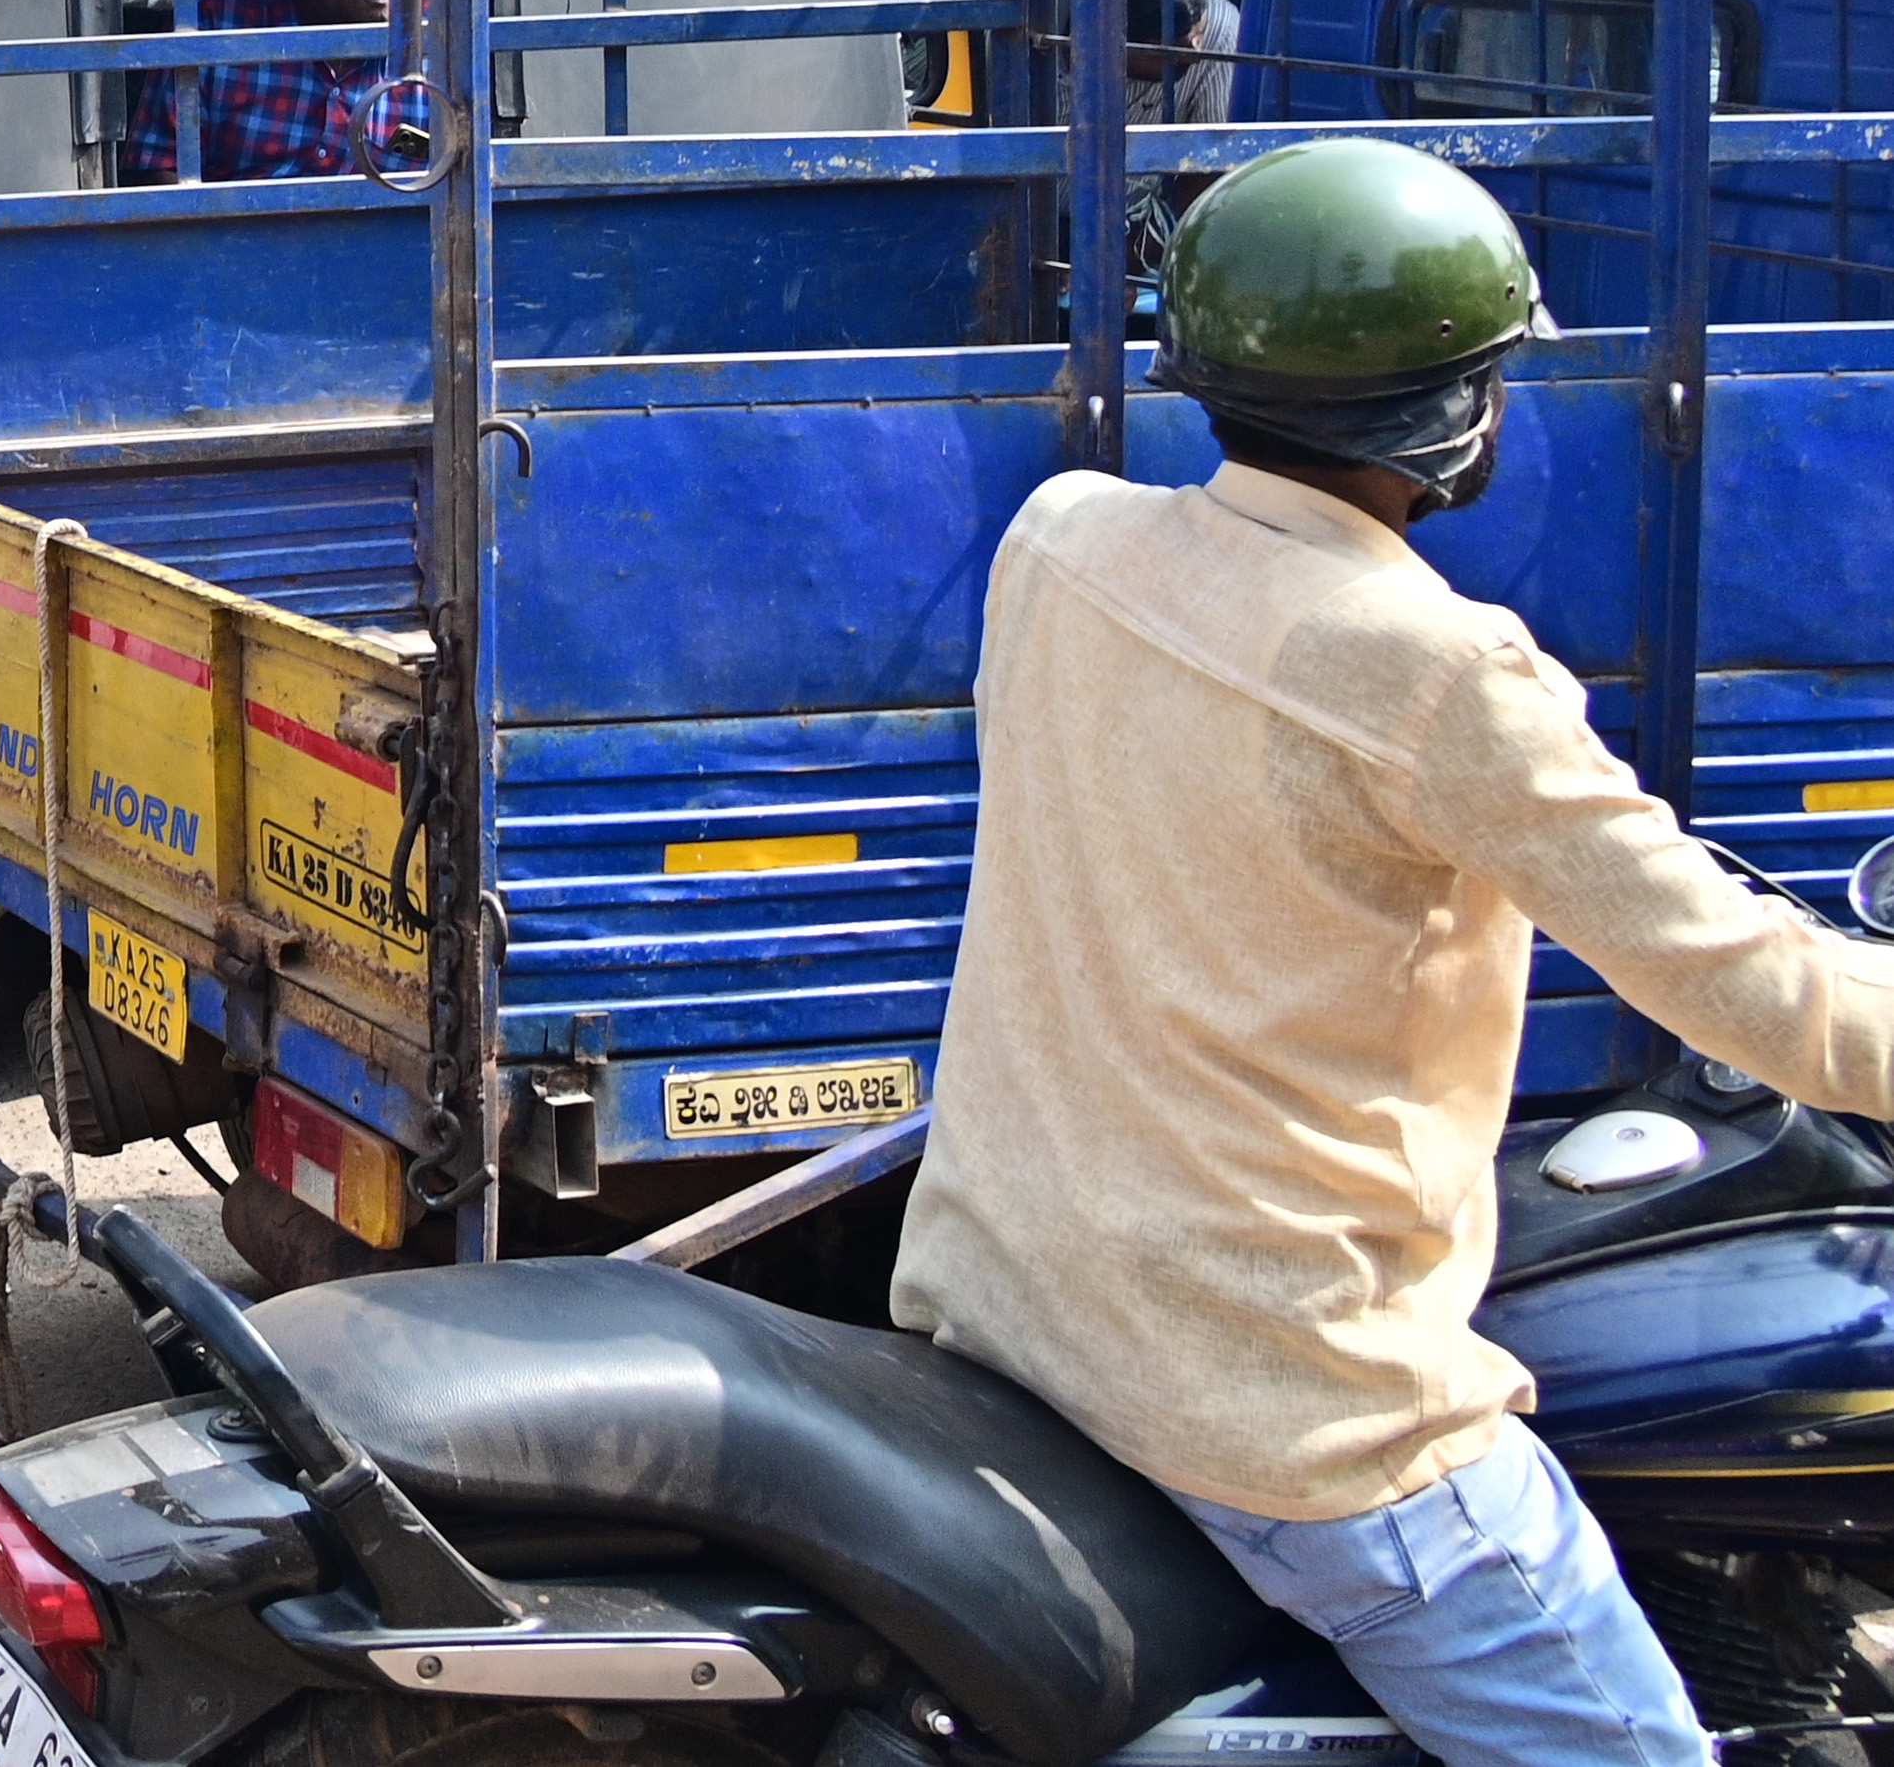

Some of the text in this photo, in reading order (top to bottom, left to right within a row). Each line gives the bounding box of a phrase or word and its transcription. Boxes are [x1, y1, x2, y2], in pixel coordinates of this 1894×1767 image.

[89, 770, 200, 857] HORN
[267, 834, 297, 884] KA
[302, 852, 329, 897] 25
[335, 867, 353, 907] D
[110, 929, 166, 996] KA25
[103, 972, 171, 1047] D8346
[1205, 1729, 1309, 1753] 150
